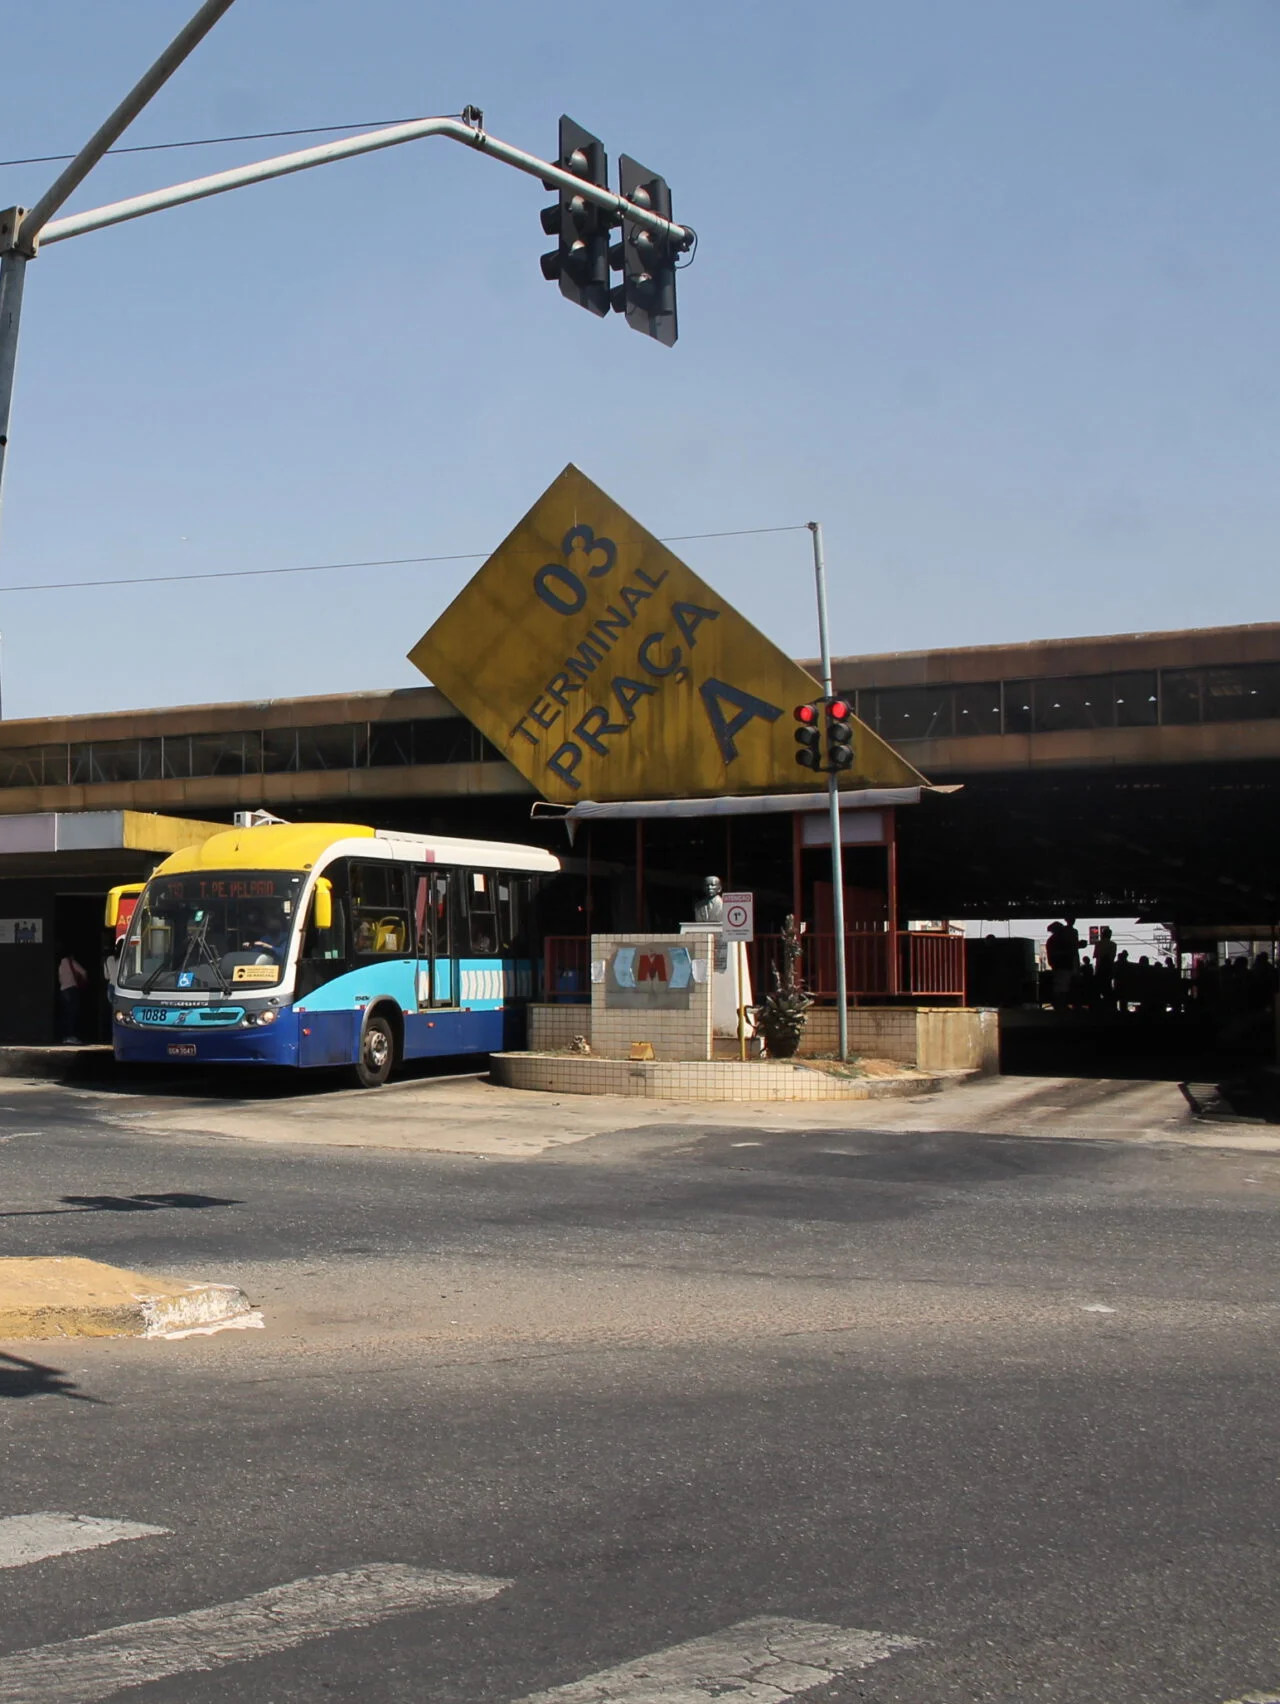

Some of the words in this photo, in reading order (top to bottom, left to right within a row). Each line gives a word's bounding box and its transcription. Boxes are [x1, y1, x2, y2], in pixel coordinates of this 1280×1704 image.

[533, 523, 617, 616] 03
[511, 567, 670, 745] TERMINAL
[547, 601, 720, 790] PRAÇA
[699, 676, 786, 767] A
[141, 1008, 168, 1022] 1088
